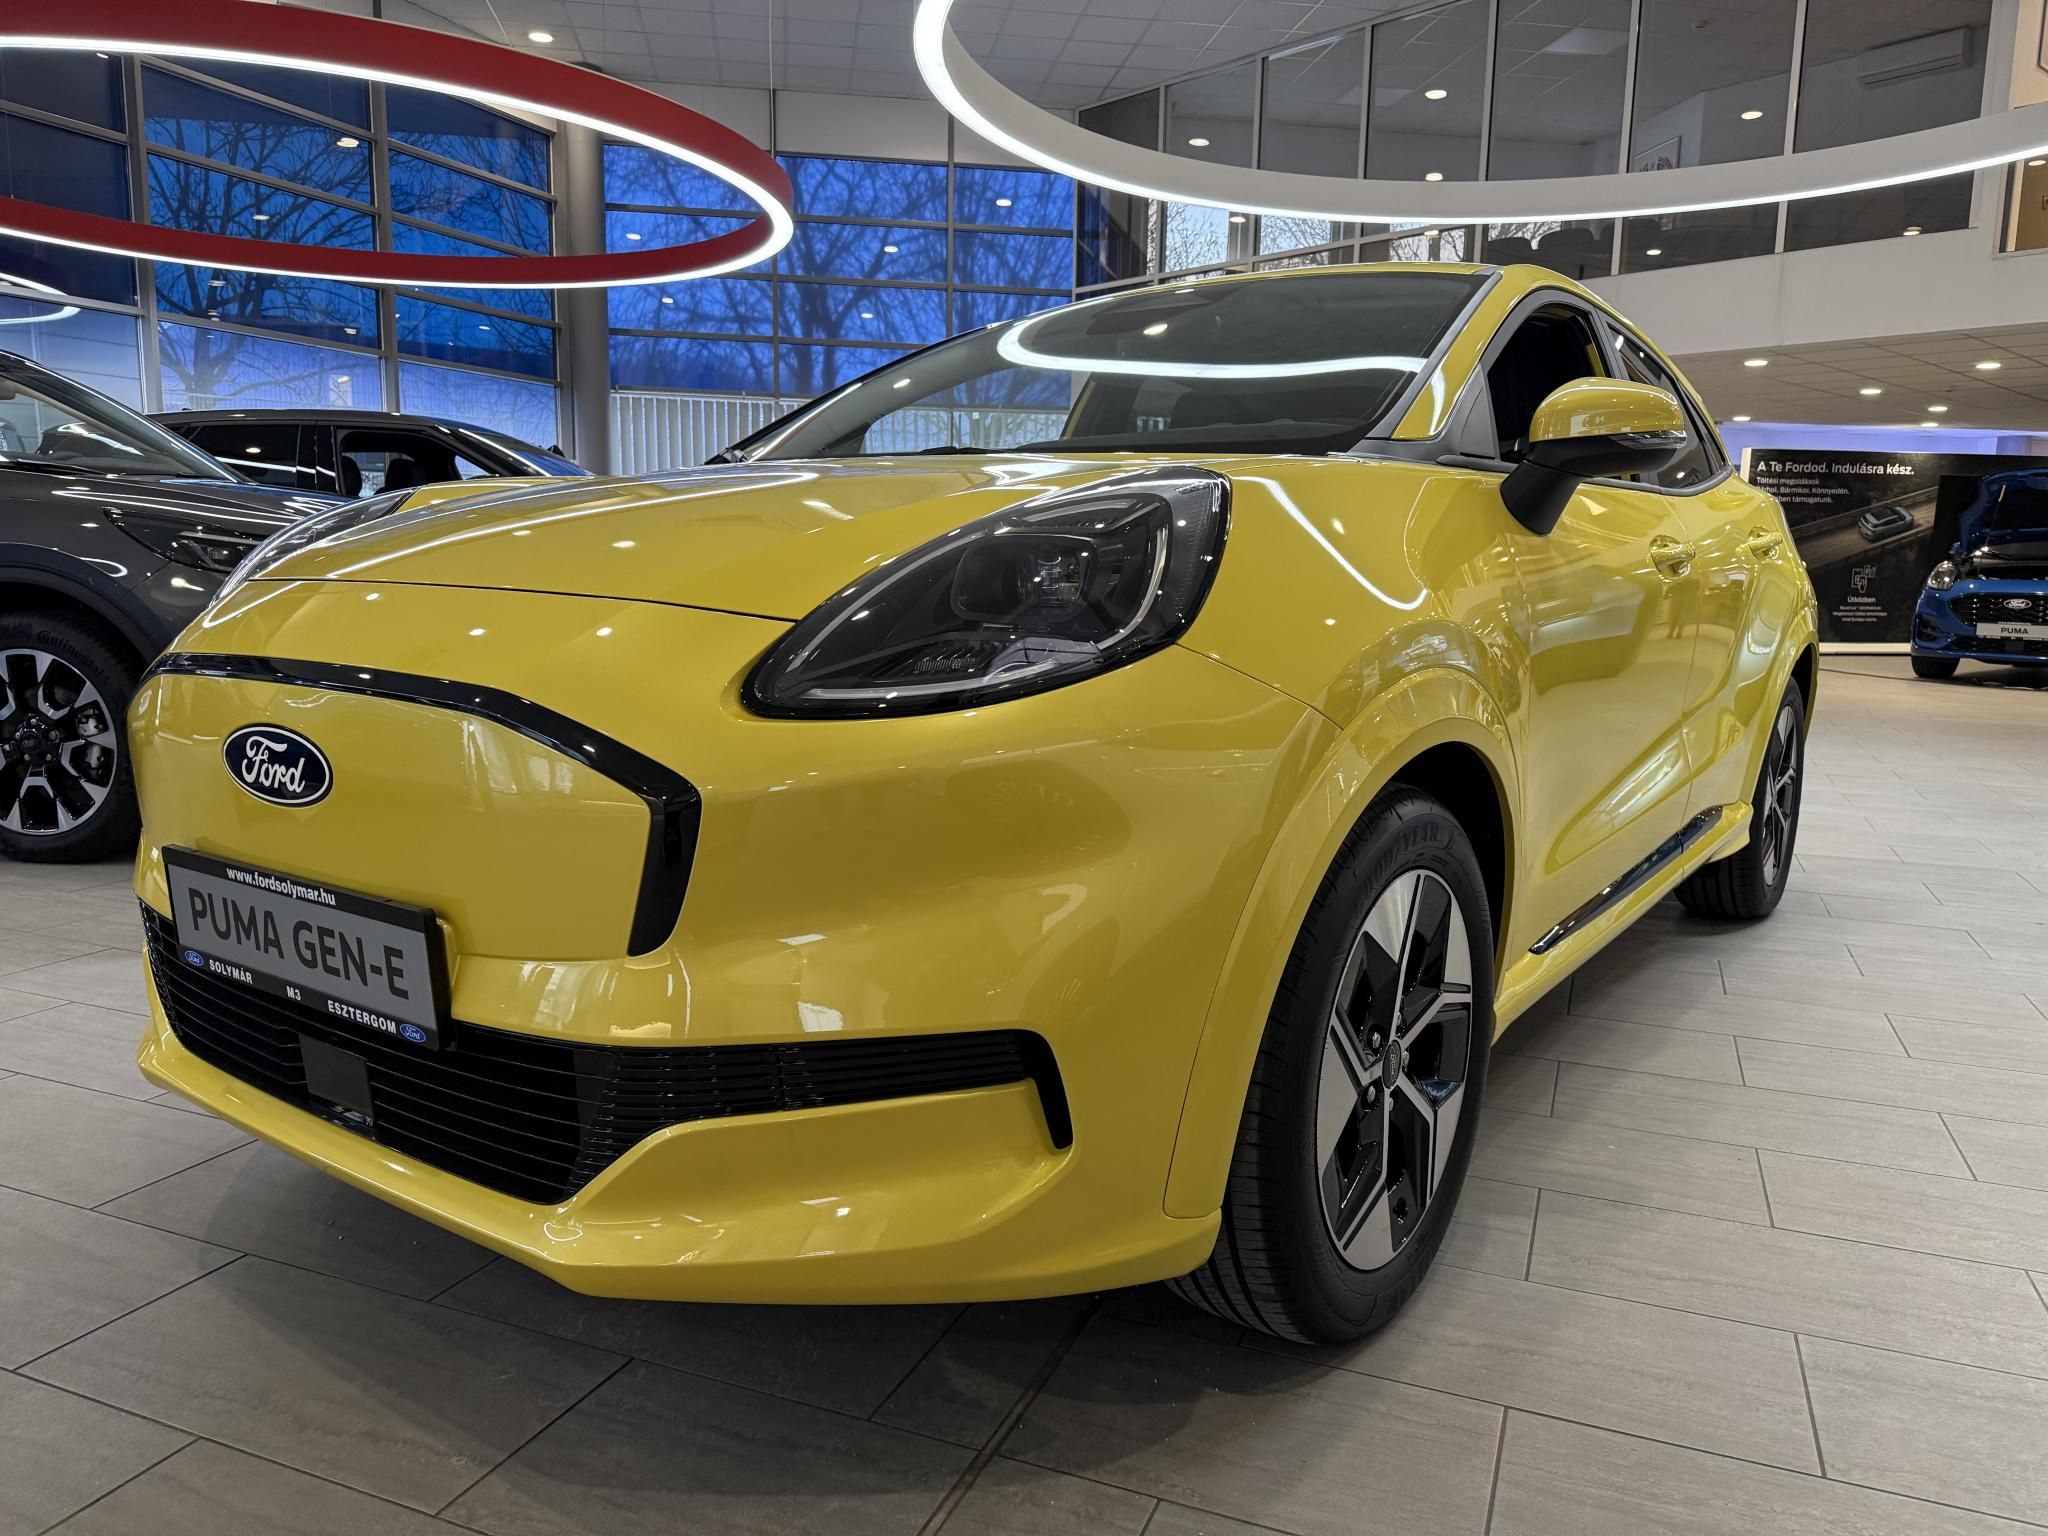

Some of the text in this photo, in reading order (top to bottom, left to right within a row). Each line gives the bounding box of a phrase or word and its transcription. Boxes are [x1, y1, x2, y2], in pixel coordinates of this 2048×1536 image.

[1757, 461, 1915, 476] A Te Fordod. Indulásra kész.
[2000, 627, 2029, 635] PUMA
[242, 736, 305, 793] Ford
[226, 867, 336, 906] www.fordsolymar.hu
[188, 887, 410, 1000] PUMA GEN-E
[209, 959, 253, 985] SOLYMÁR
[286, 985, 301, 1000] M3
[327, 1000, 397, 1035] ESZTERGOM
